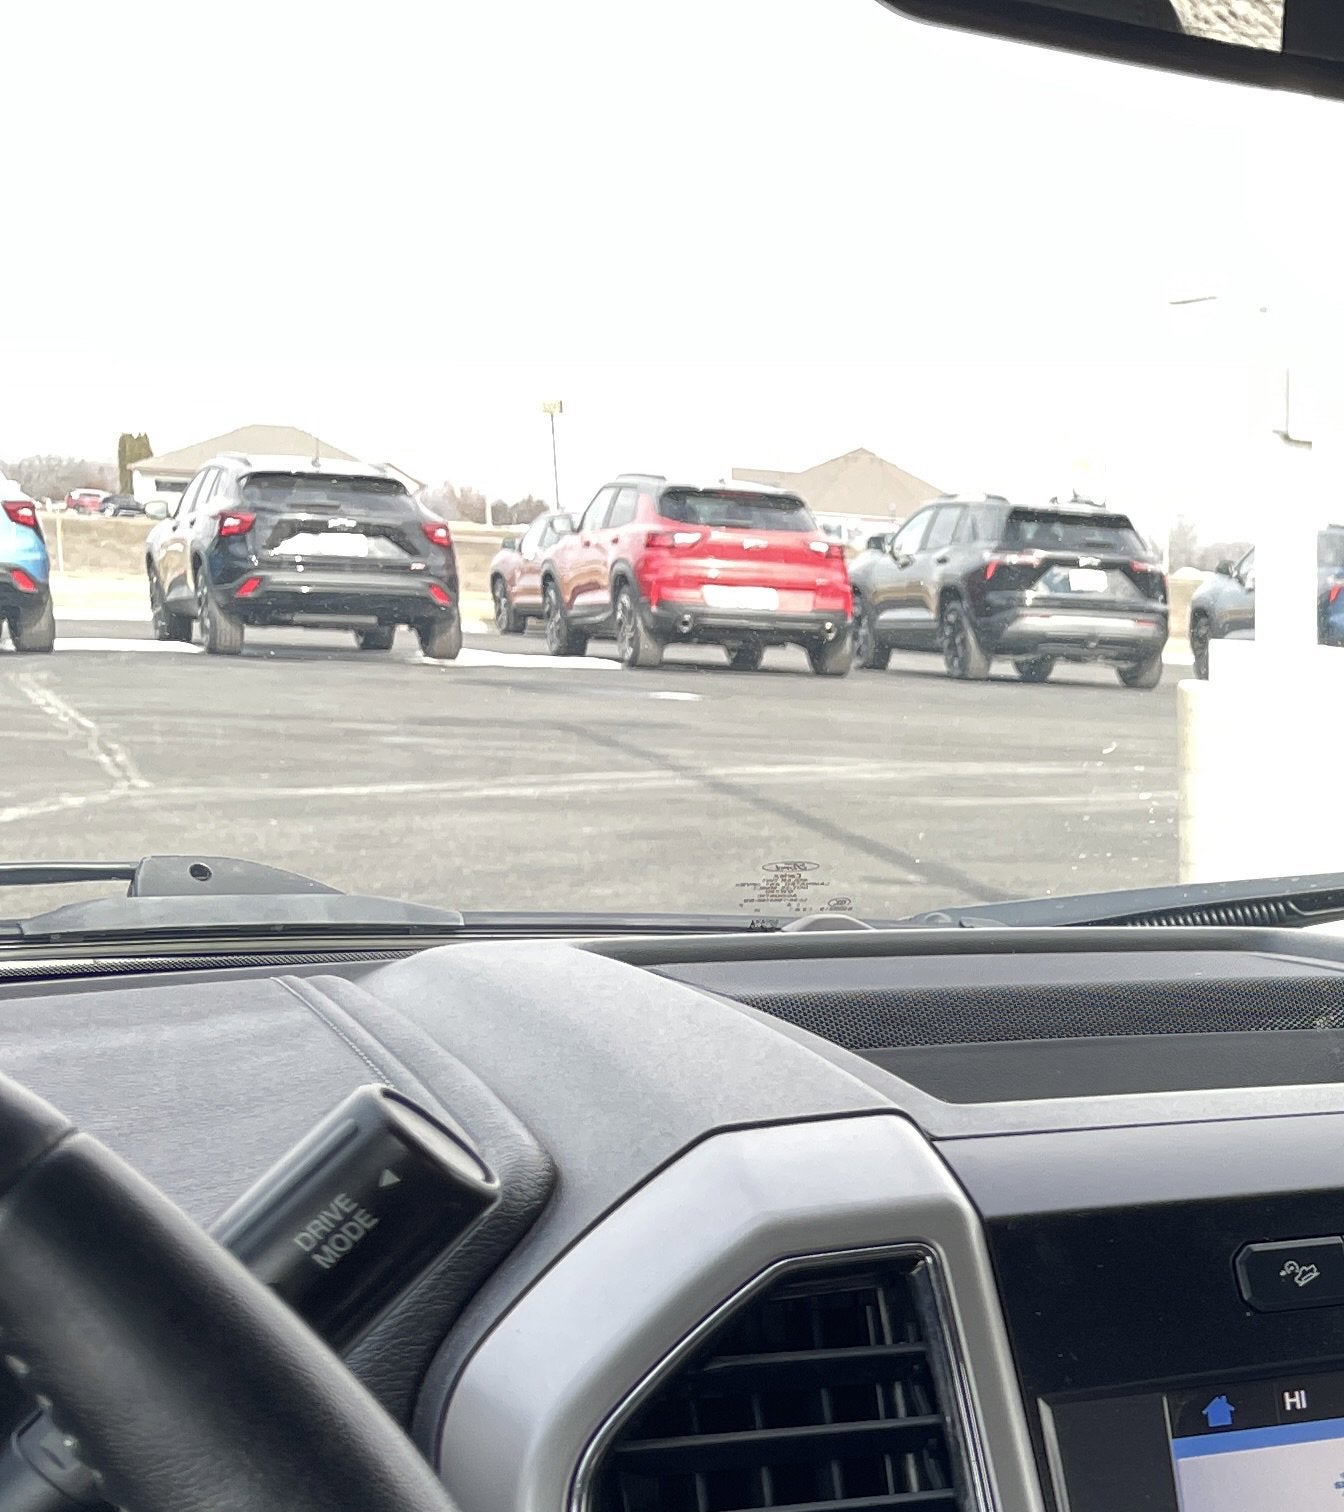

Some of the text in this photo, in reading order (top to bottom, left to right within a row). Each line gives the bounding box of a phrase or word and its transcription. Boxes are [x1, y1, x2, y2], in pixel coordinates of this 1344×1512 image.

[295, 1193, 358, 1252] DRIVE
[312, 1208, 379, 1269] MODE
[1284, 1391, 1307, 1410] HI
